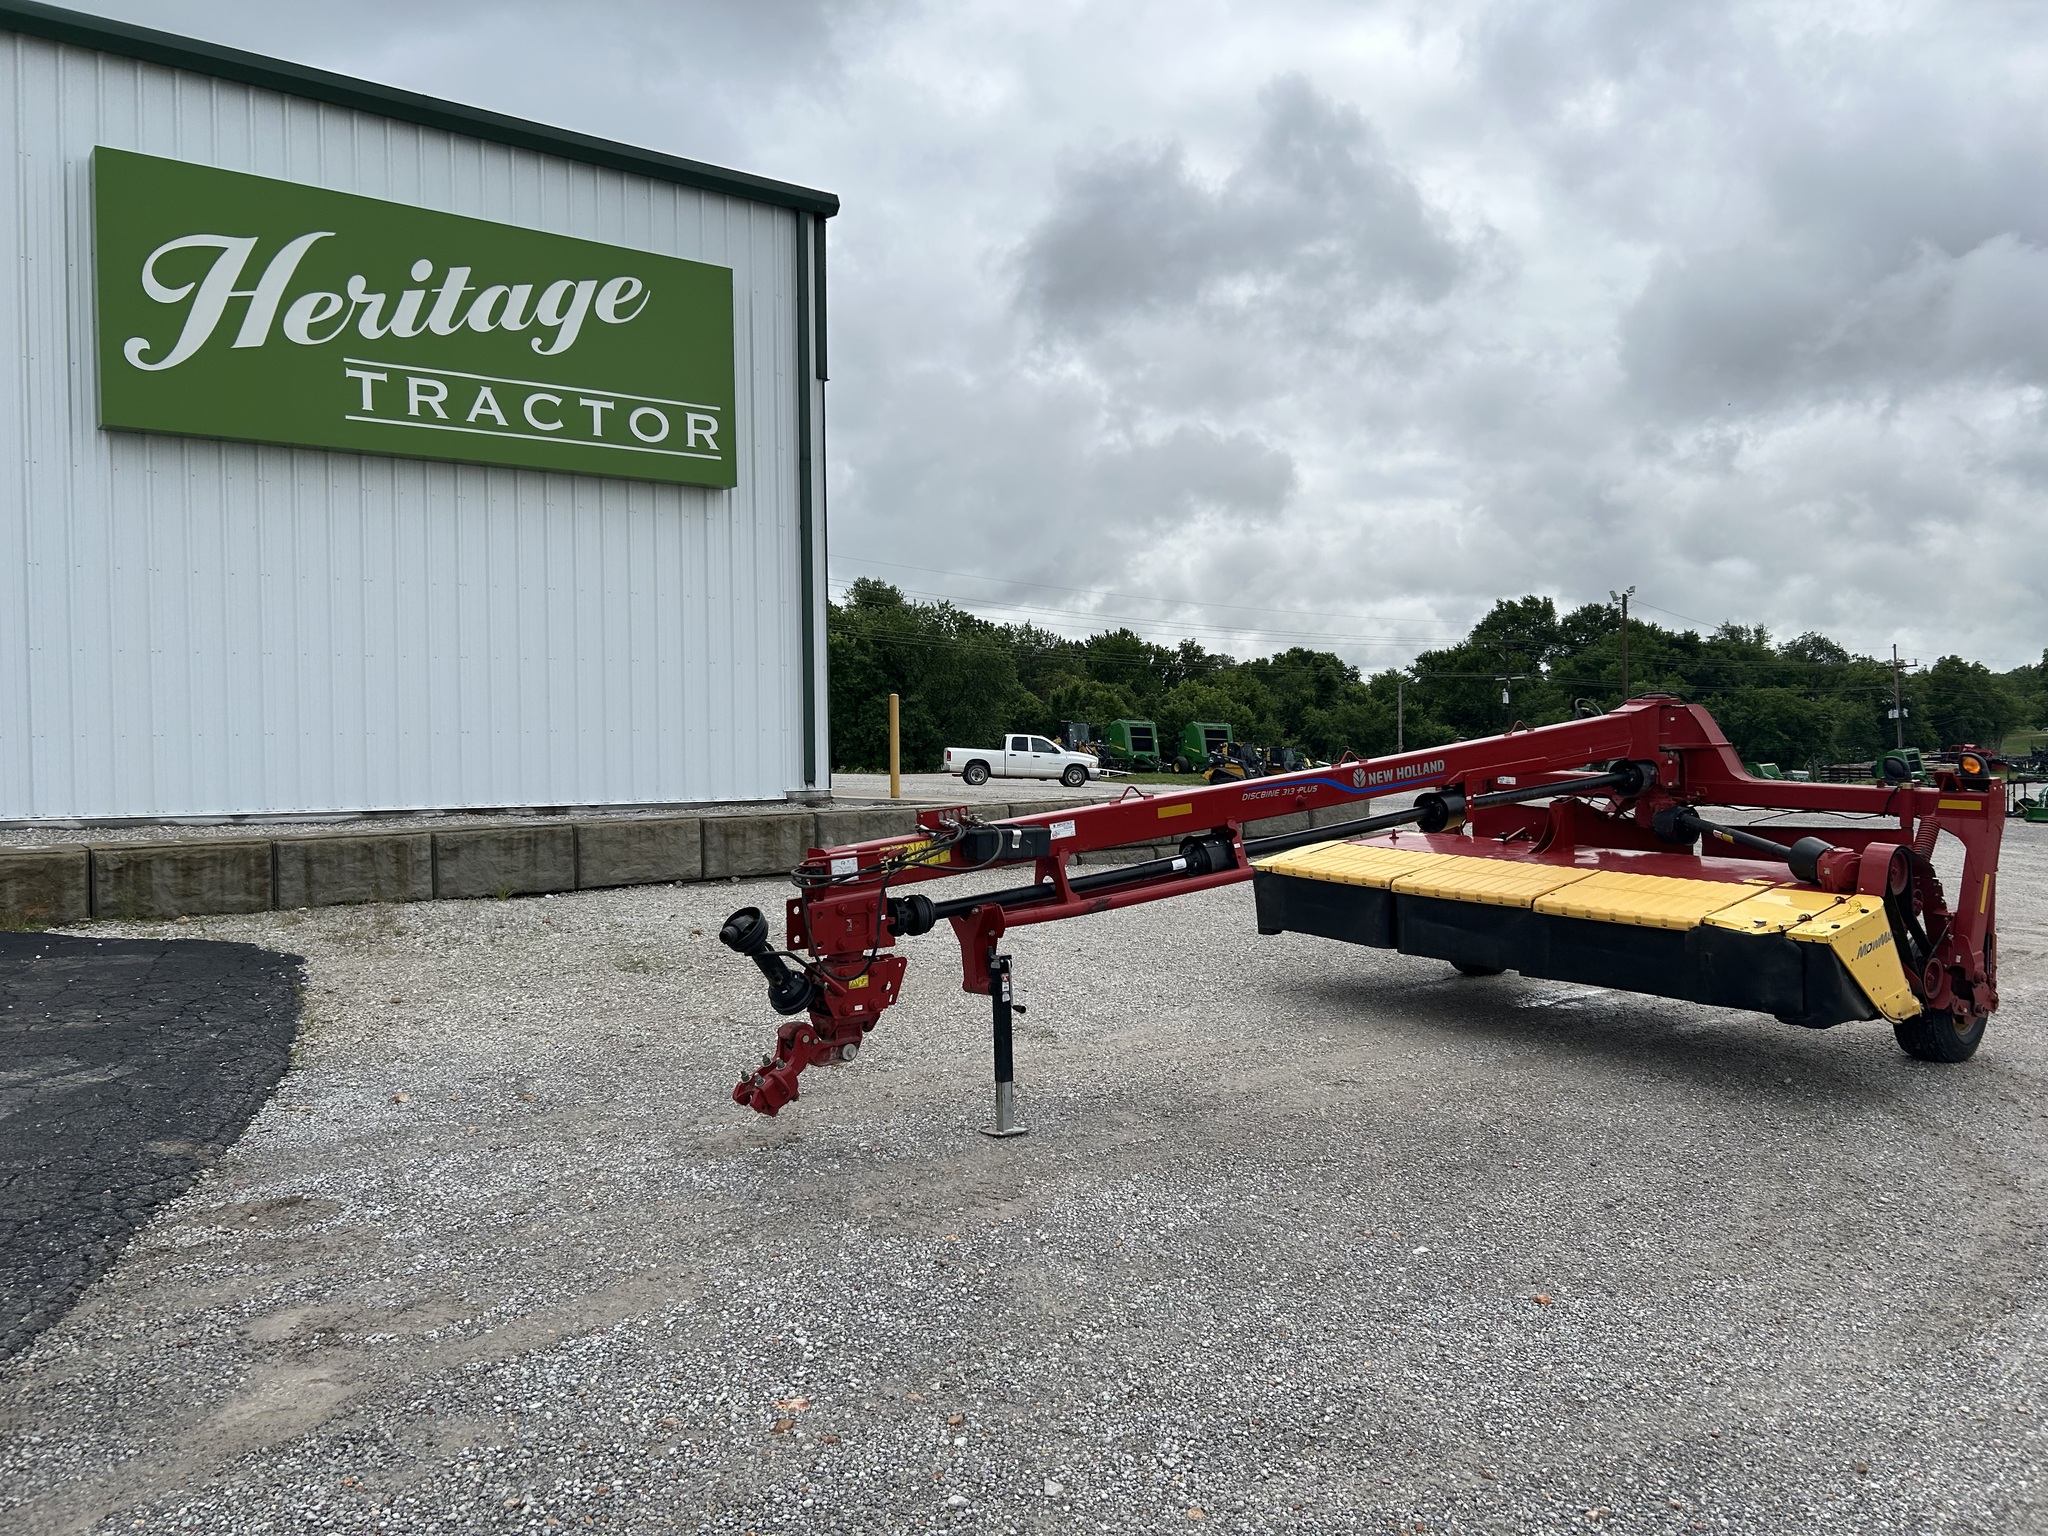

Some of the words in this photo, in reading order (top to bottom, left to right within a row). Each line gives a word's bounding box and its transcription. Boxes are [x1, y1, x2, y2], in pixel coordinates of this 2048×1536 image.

[124, 231, 650, 372] Heritage
[345, 367, 721, 450] TRACTOR
[1241, 789, 1280, 801] DISCBINE
[1281, 788, 1295, 796] 313
[1297, 785, 1318, 794] PLUS
[1368, 769, 1393, 785] NEW
[1396, 760, 1445, 780] HOLLAND
